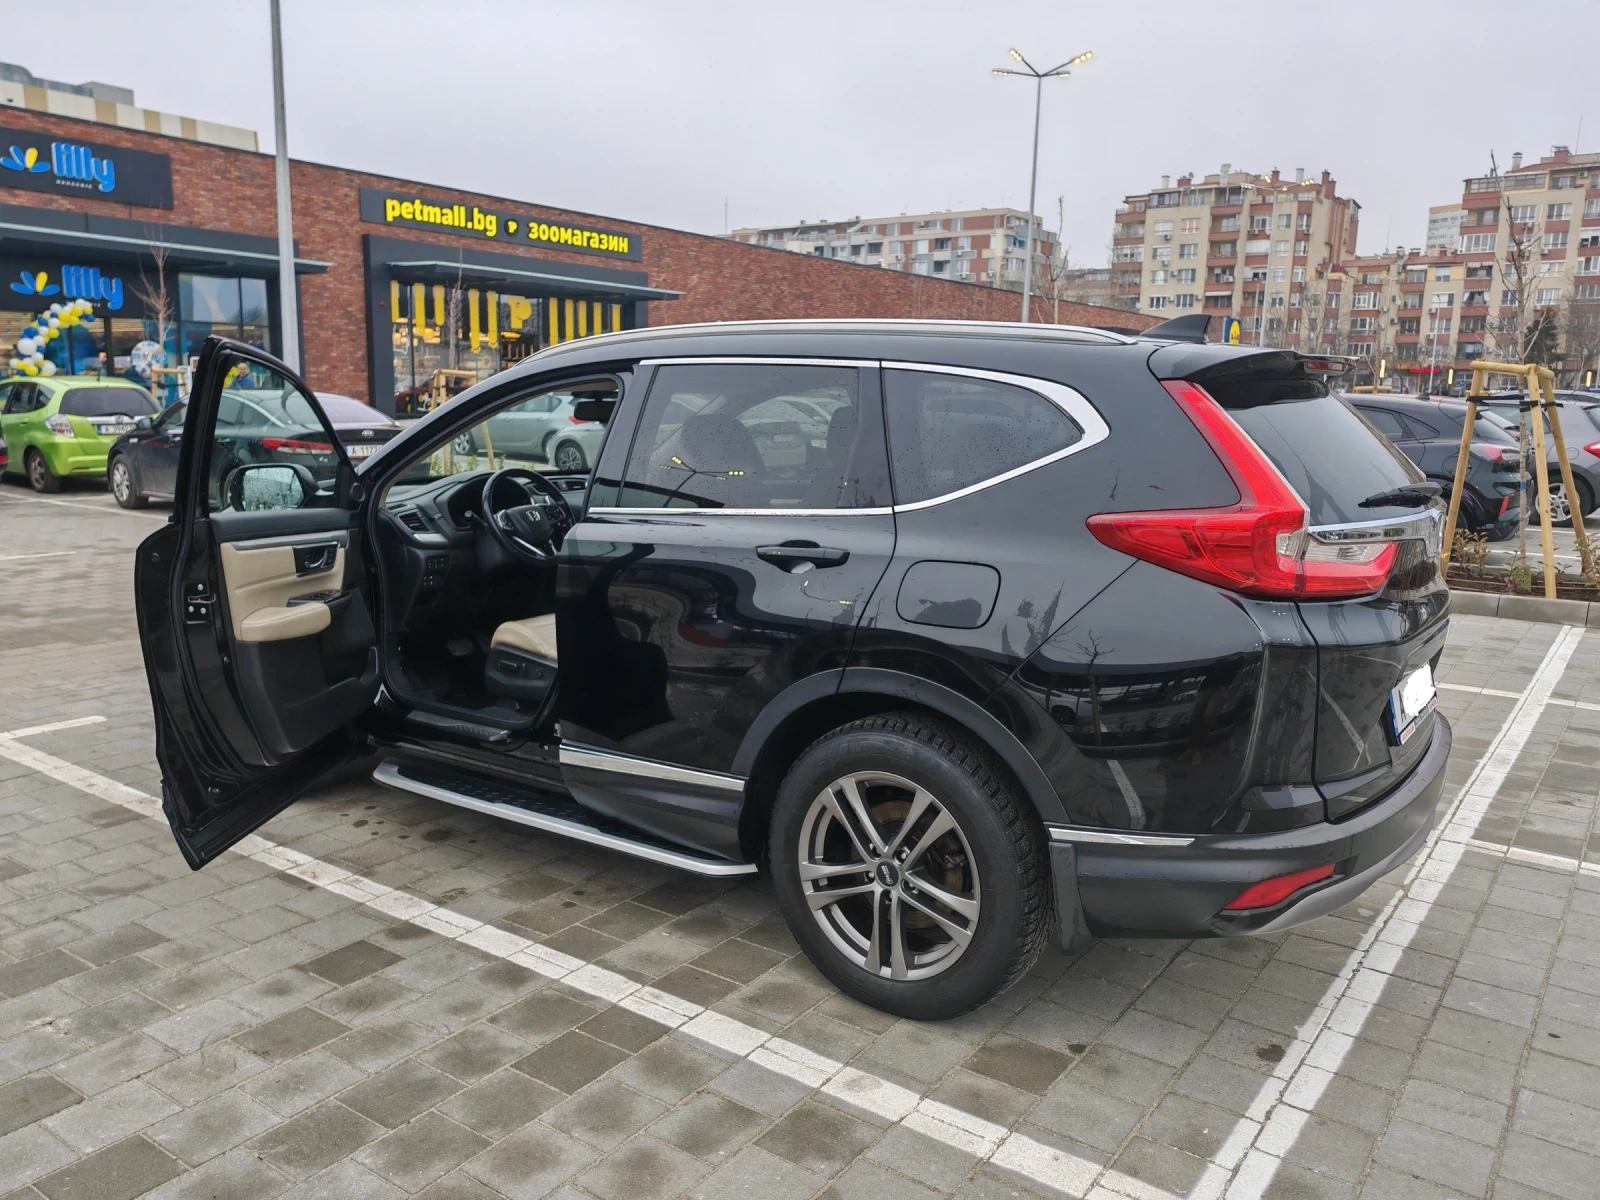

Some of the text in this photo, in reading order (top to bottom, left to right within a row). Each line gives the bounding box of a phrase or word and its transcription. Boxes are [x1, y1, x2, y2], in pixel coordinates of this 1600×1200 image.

[51, 142, 115, 192] lilly
[385, 198, 497, 237] petmall.bg
[528, 222, 629, 254] зоомагазин
[62, 265, 123, 310] lilly
